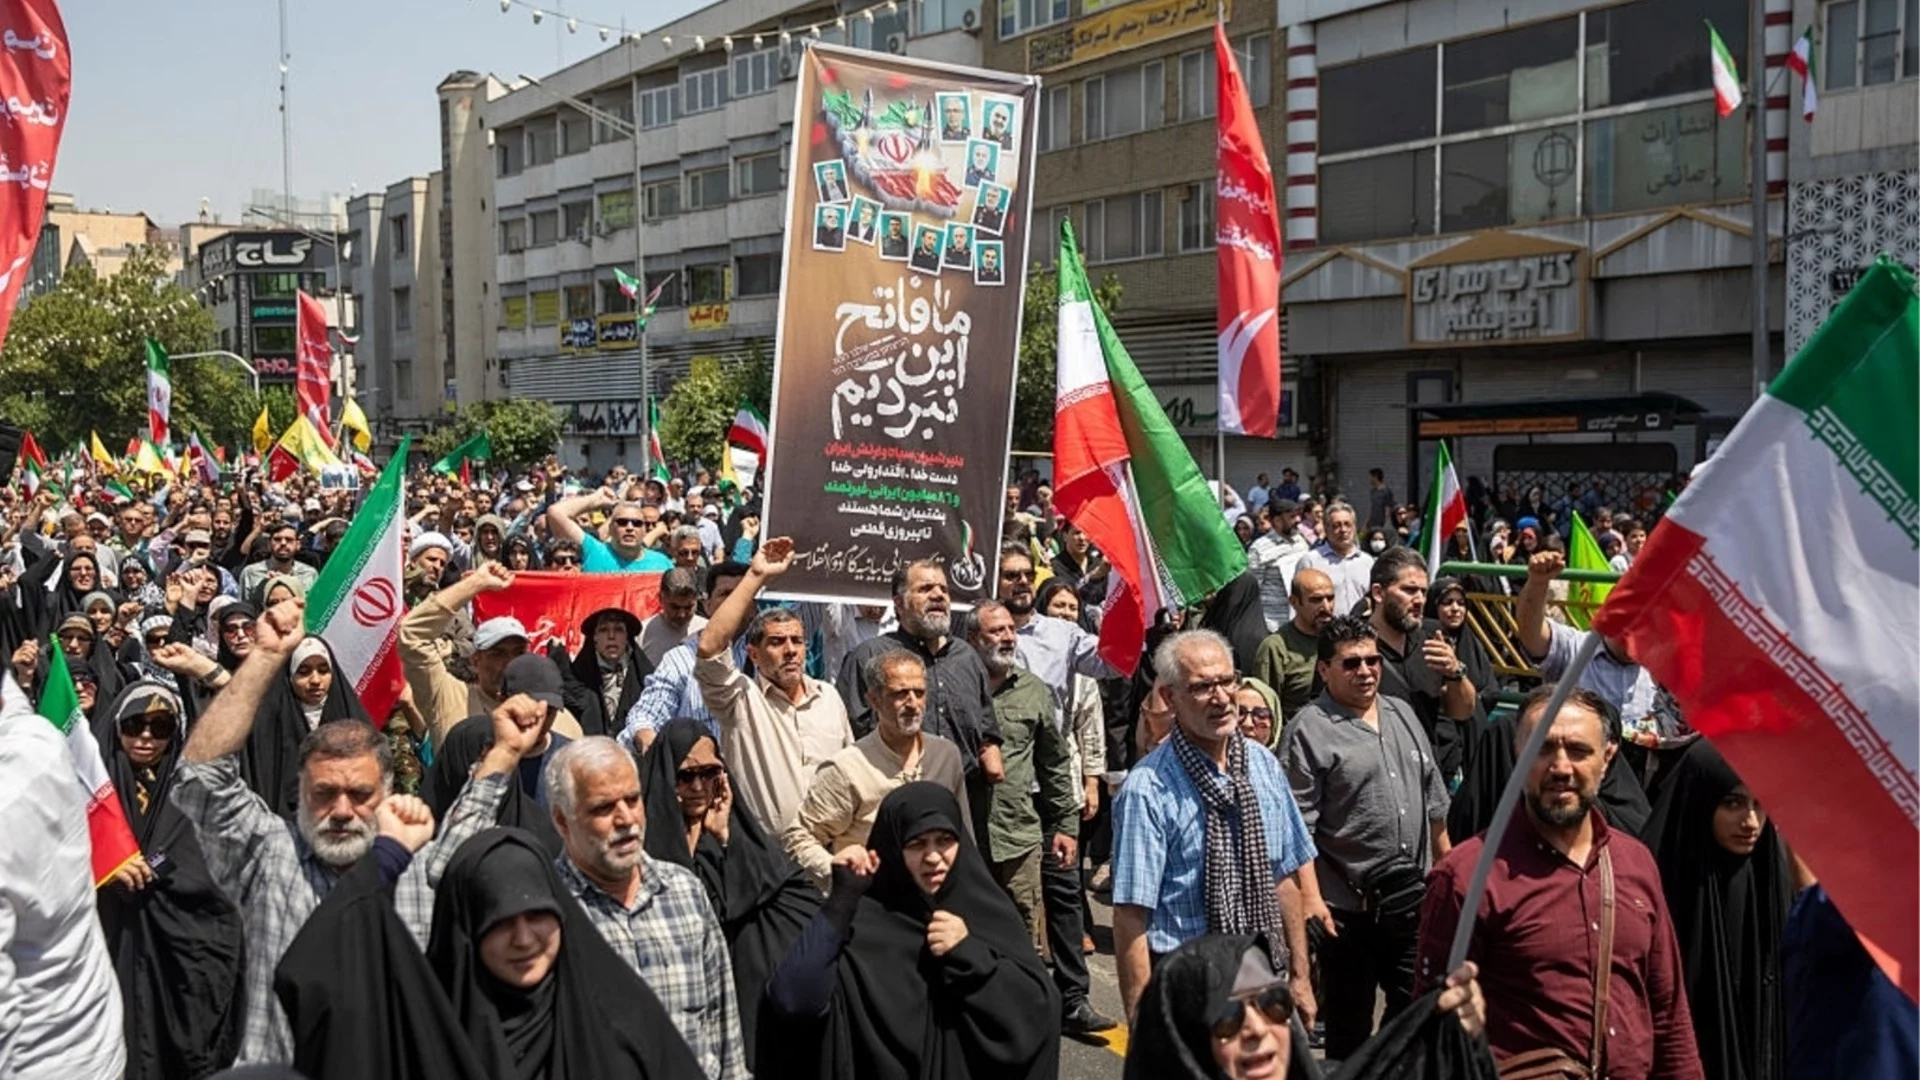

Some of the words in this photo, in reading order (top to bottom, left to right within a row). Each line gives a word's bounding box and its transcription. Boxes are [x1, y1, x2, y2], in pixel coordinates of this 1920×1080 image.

[236, 239, 311, 265] گاج
[834, 275, 931, 356] فاتح
[895, 335, 969, 390] این
[831, 460, 853, 473] خدا
[838, 500, 880, 517] هستند
[880, 504, 903, 518] شما
[902, 506, 946, 526] پشتیبان
[850, 521, 885, 538] قطعی
[884, 525, 921, 543] پیروزی
